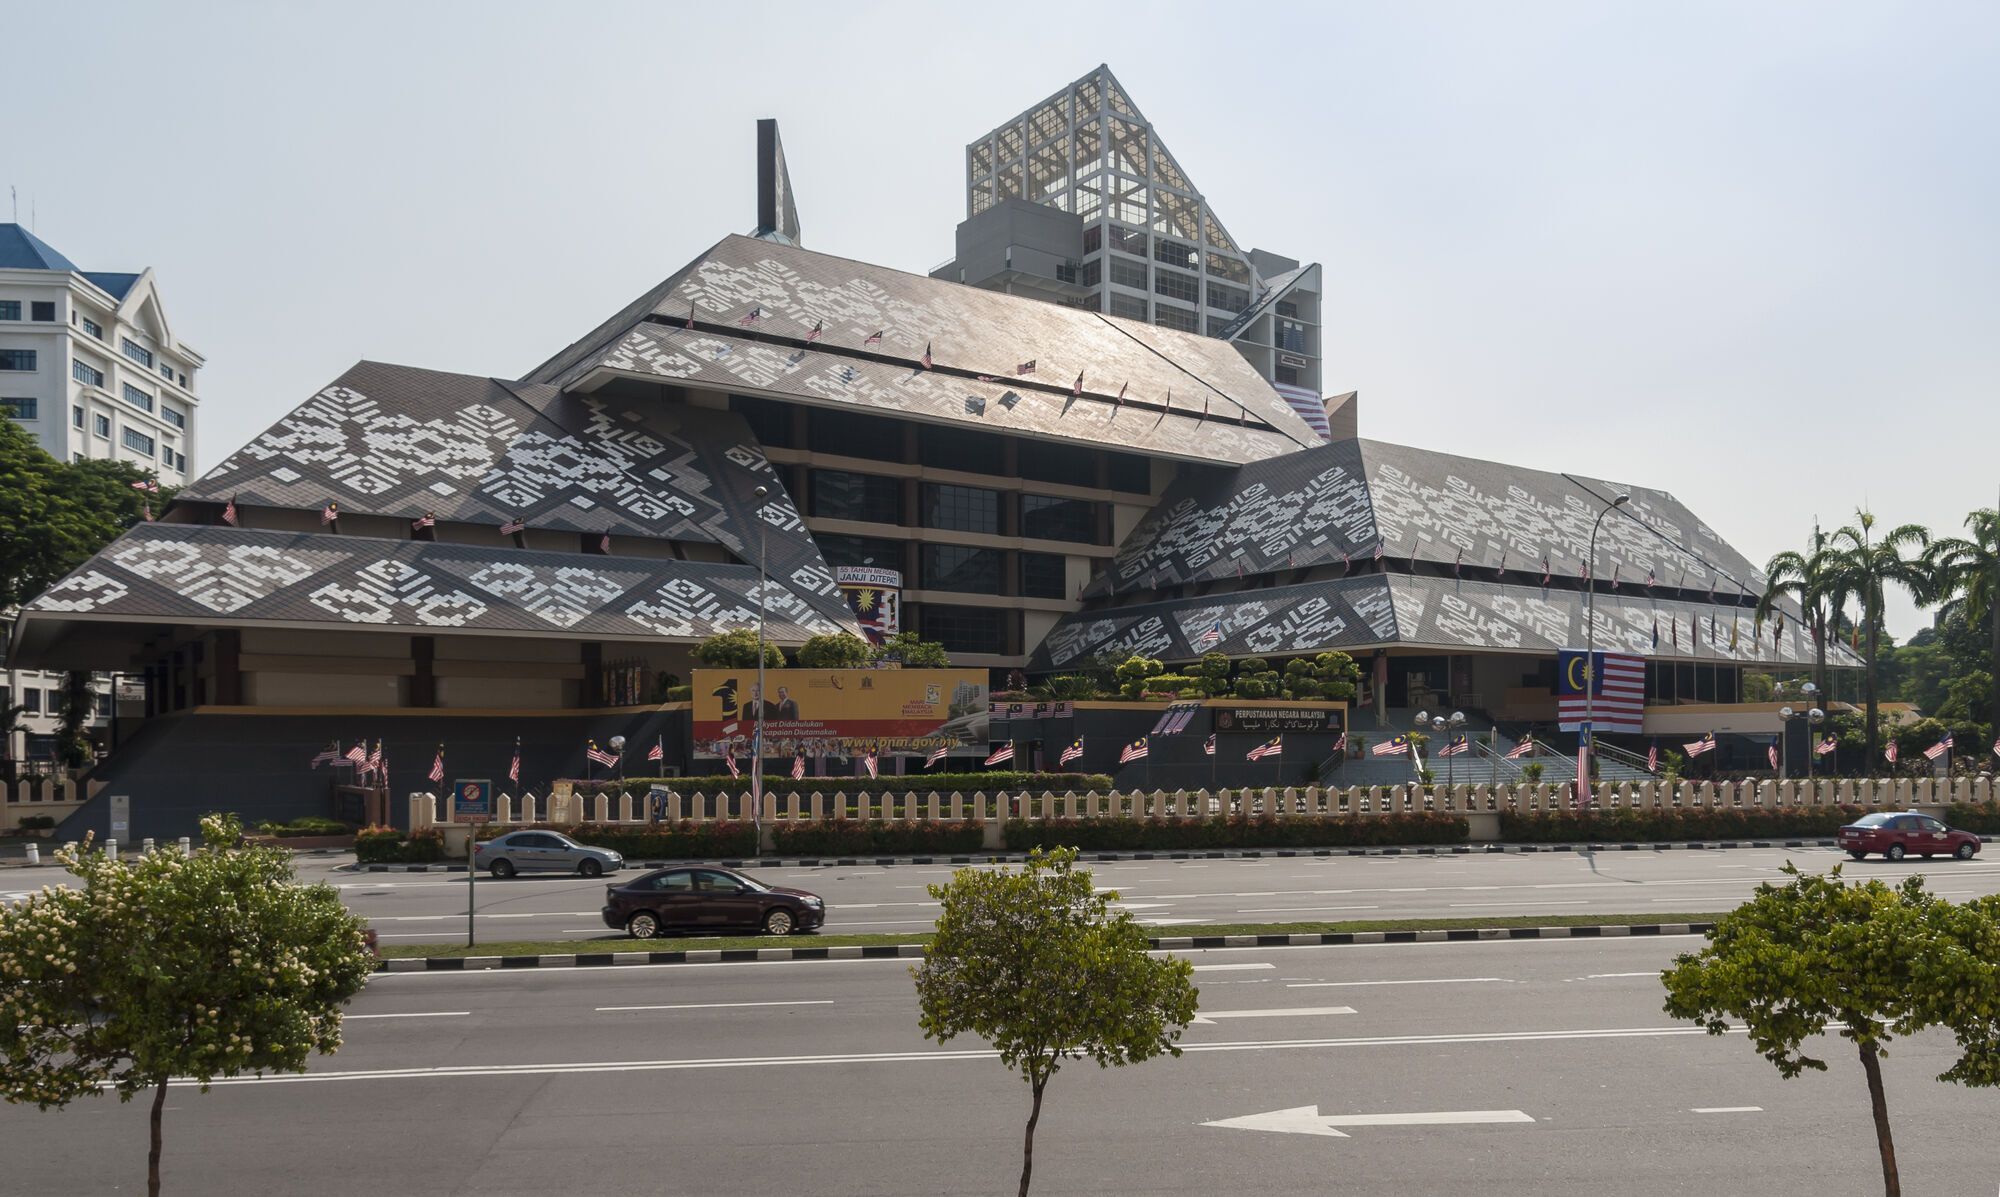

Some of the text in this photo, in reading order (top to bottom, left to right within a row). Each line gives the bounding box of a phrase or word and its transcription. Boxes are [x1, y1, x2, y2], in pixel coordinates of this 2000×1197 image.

[850, 566, 873, 574] TAHUN
[840, 573, 898, 585] JANJI DITEPATI
[1235, 709, 1326, 719] PERPUSTAKAAN NEGARA MALAYSIA
[753, 720, 824, 729] Rkyat Didahulukan
[793, 728, 838, 736] Diutamakan
